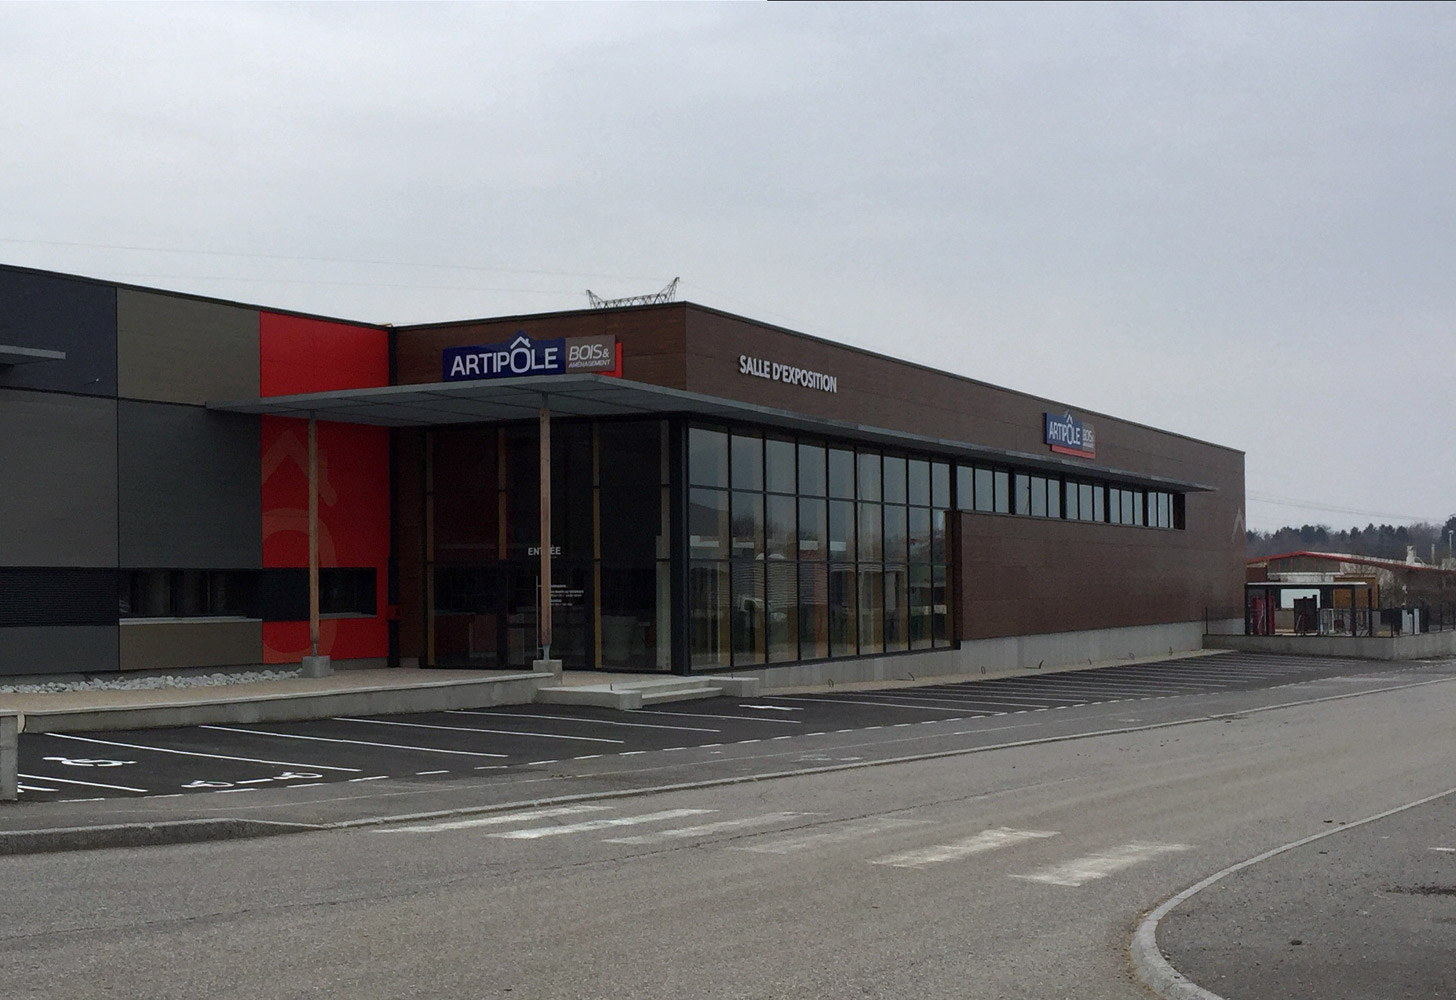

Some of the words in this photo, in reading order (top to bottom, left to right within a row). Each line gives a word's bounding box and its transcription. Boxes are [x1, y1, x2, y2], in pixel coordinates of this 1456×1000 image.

[450, 336, 558, 376] ARTIPÔLE
[739, 354, 770, 379] SALLE
[772, 362, 837, 393] D'EXPOSITION
[1048, 414, 1081, 445] ARTIPÔLE
